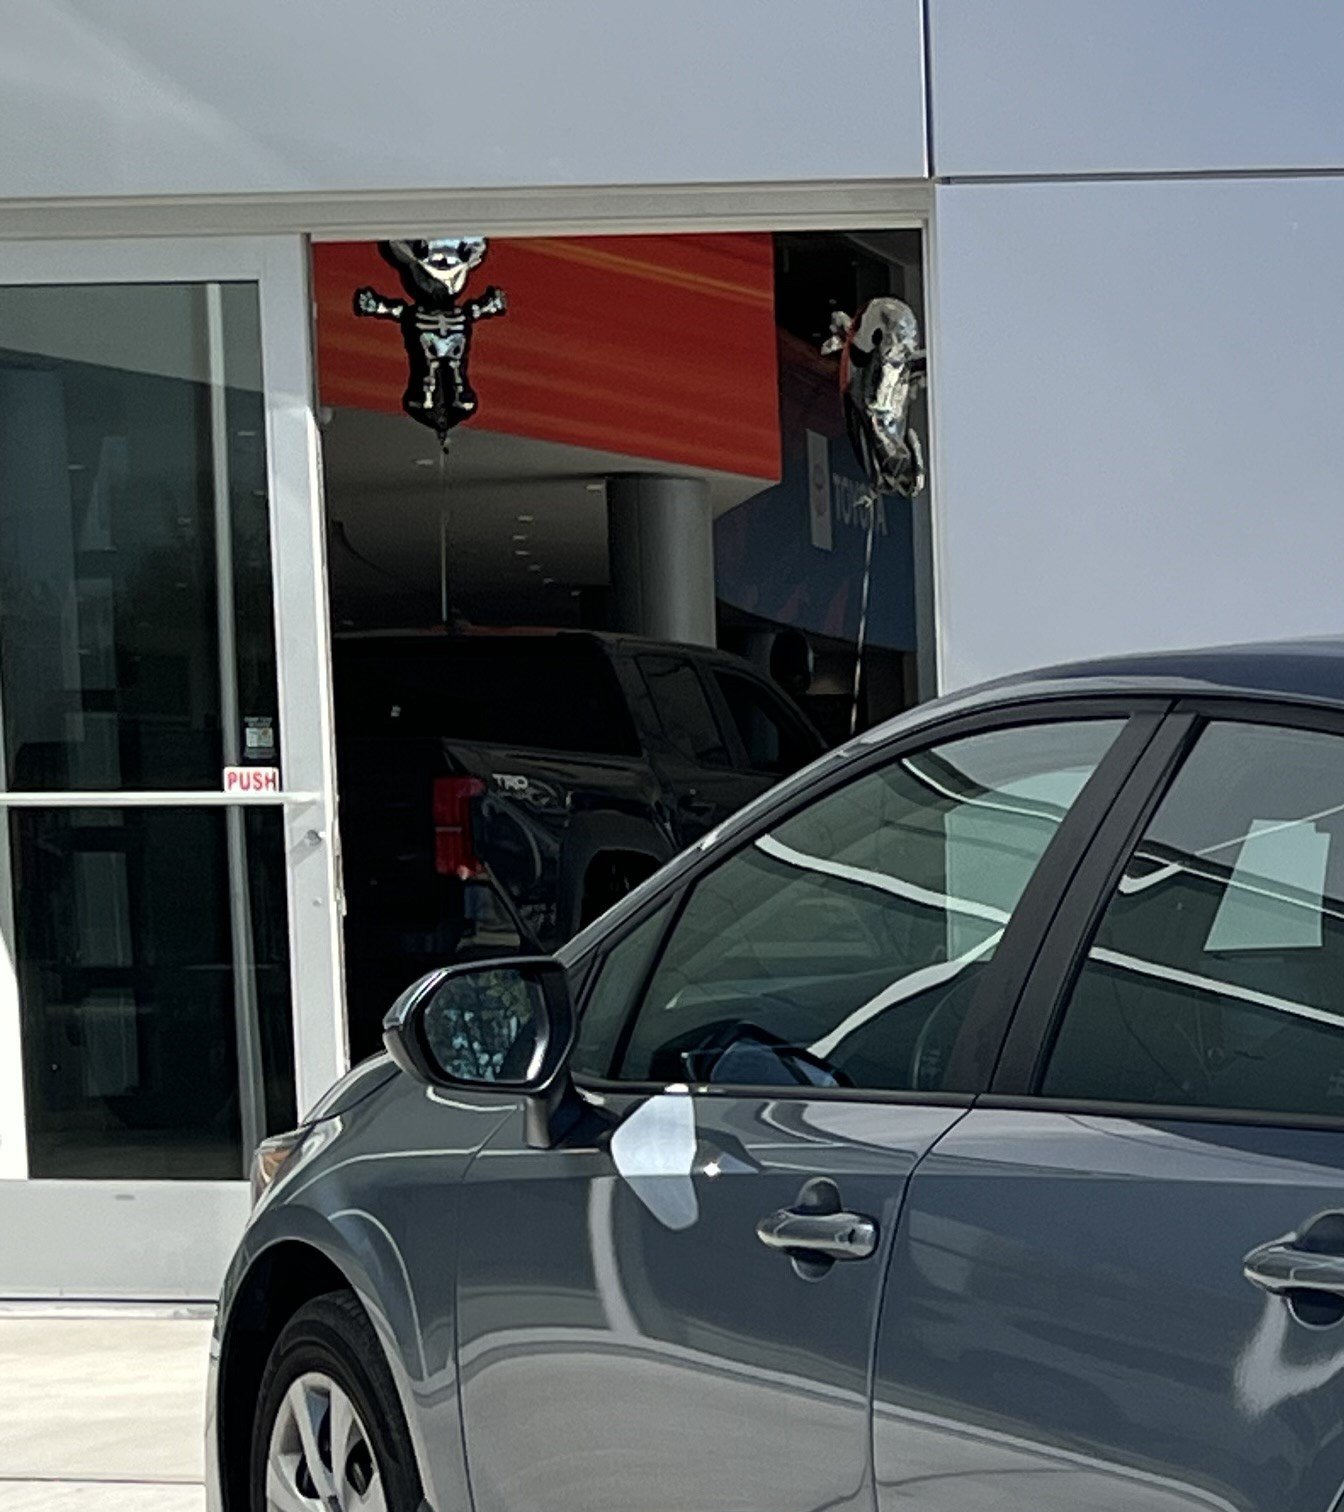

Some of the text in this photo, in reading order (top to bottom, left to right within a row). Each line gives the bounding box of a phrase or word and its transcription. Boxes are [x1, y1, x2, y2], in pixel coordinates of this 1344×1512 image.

[833, 472, 887, 537] TOYOA
[227, 771, 277, 792] PUSH
[491, 773, 528, 790] TRD
